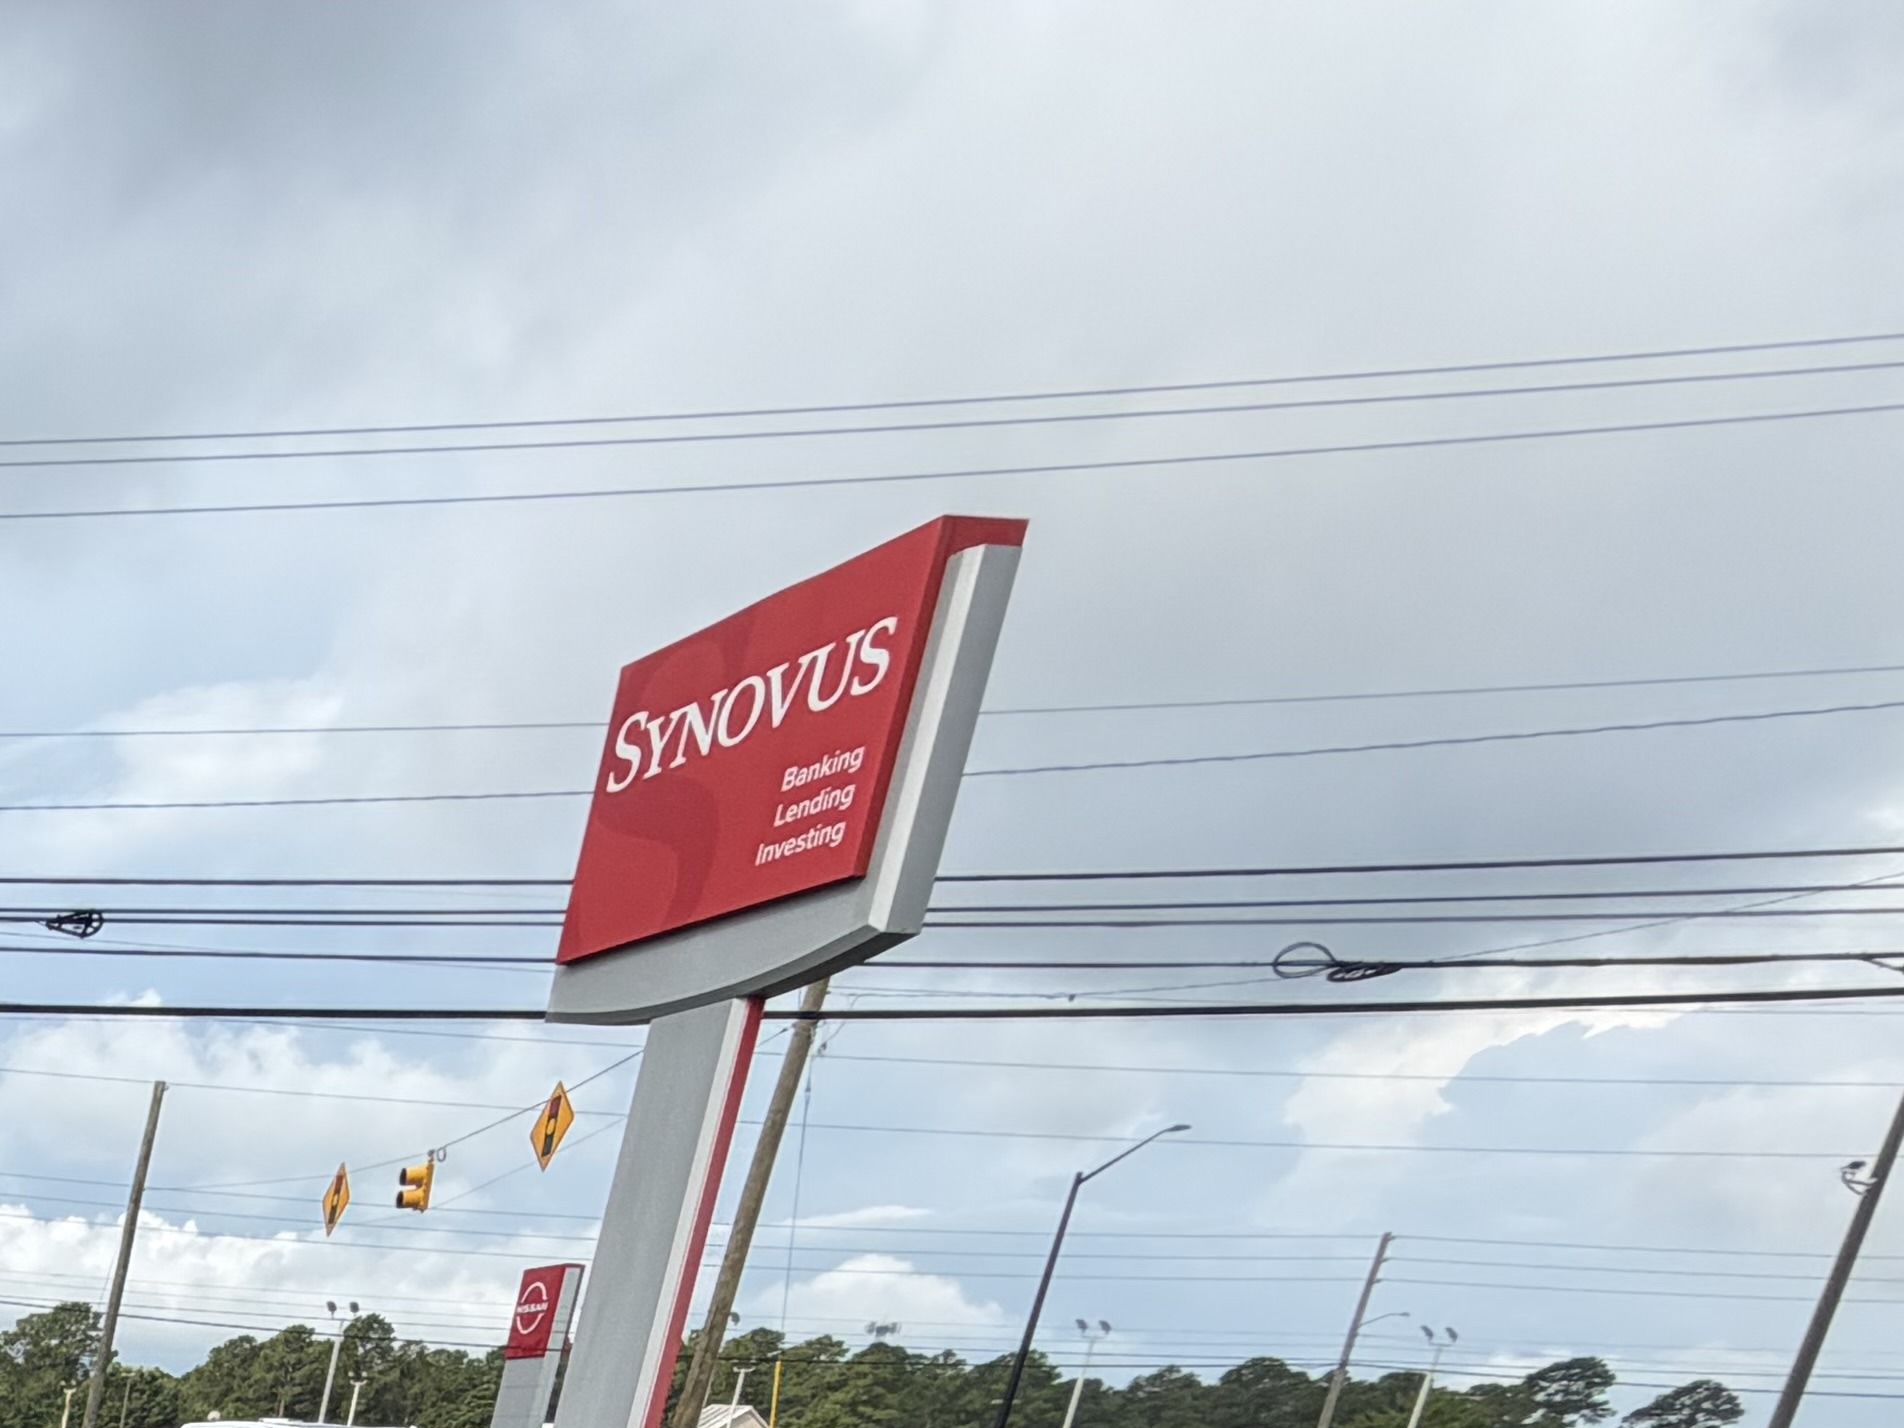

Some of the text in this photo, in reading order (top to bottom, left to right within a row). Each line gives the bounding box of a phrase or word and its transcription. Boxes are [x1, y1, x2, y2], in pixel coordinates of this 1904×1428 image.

[606, 616, 898, 793] SYNOVUS
[781, 745, 866, 792] Banking
[773, 782, 856, 828] Lending
[755, 821, 846, 867] Investing
